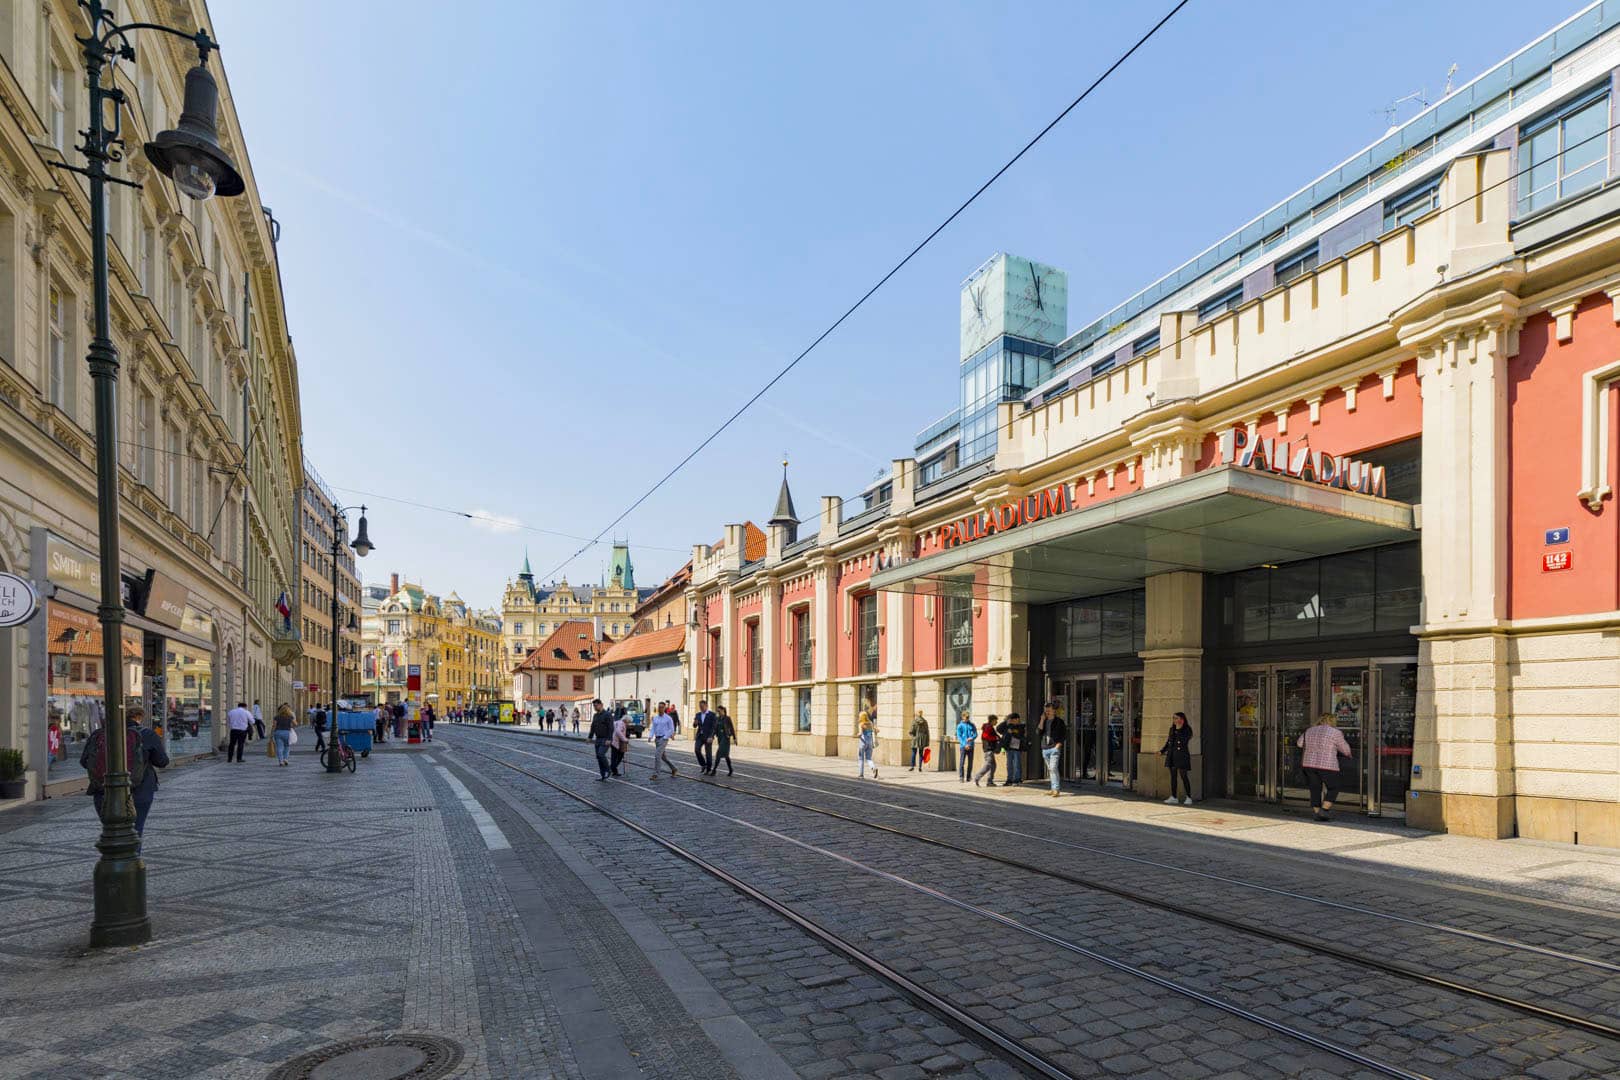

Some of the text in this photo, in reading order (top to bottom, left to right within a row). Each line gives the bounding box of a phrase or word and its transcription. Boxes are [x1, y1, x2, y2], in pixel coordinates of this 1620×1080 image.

[1231, 427, 1387, 498] PALLADIUM
[941, 484, 1068, 549] PALLADIUM
[1553, 531, 1560, 541] 3
[52, 551, 81, 580] SMITH
[1546, 553, 1567, 563] 1142
